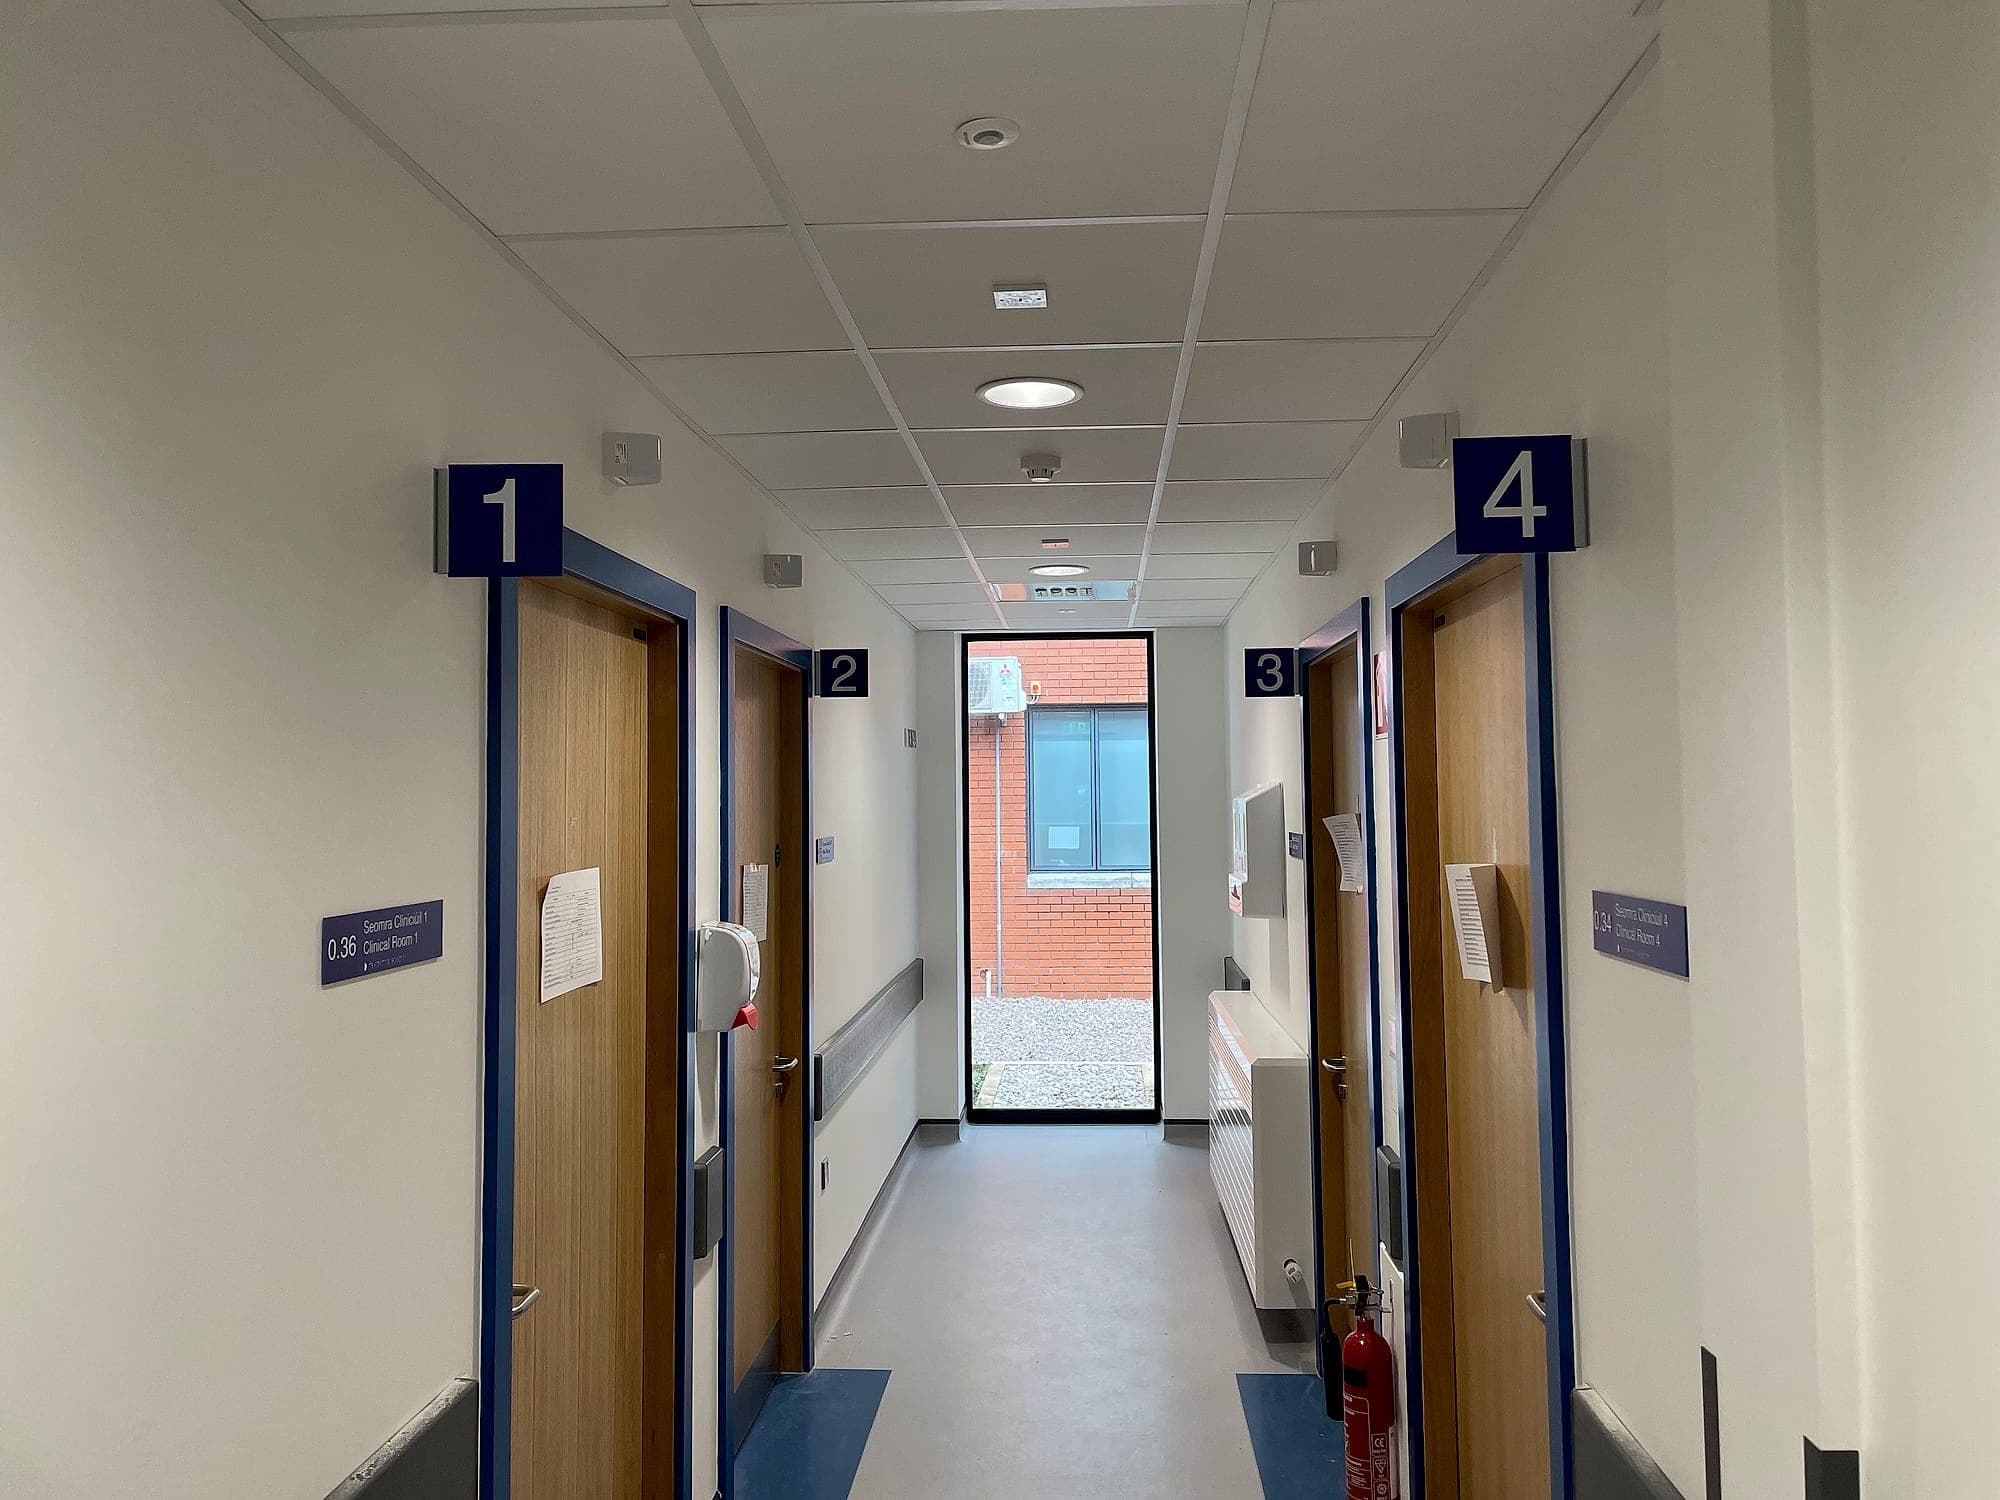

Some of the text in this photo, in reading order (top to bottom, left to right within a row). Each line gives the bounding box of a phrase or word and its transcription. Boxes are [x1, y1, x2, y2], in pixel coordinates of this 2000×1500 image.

[1483, 450, 1547, 538] 4
[482, 477, 516, 563] 1
[831, 655, 857, 691] 2
[1256, 653, 1283, 691] 3
[363, 919, 393, 934] Seomra
[423, 911, 428, 924] 1
[1594, 910, 1612, 933] 0.34
[1663, 913, 1669, 928] 4
[327, 935, 357, 961] 0.36
[363, 931, 418, 955] Clinical Room 1
[1655, 933, 1661, 947] 4
[1374, 1437, 1385, 1448] CE
